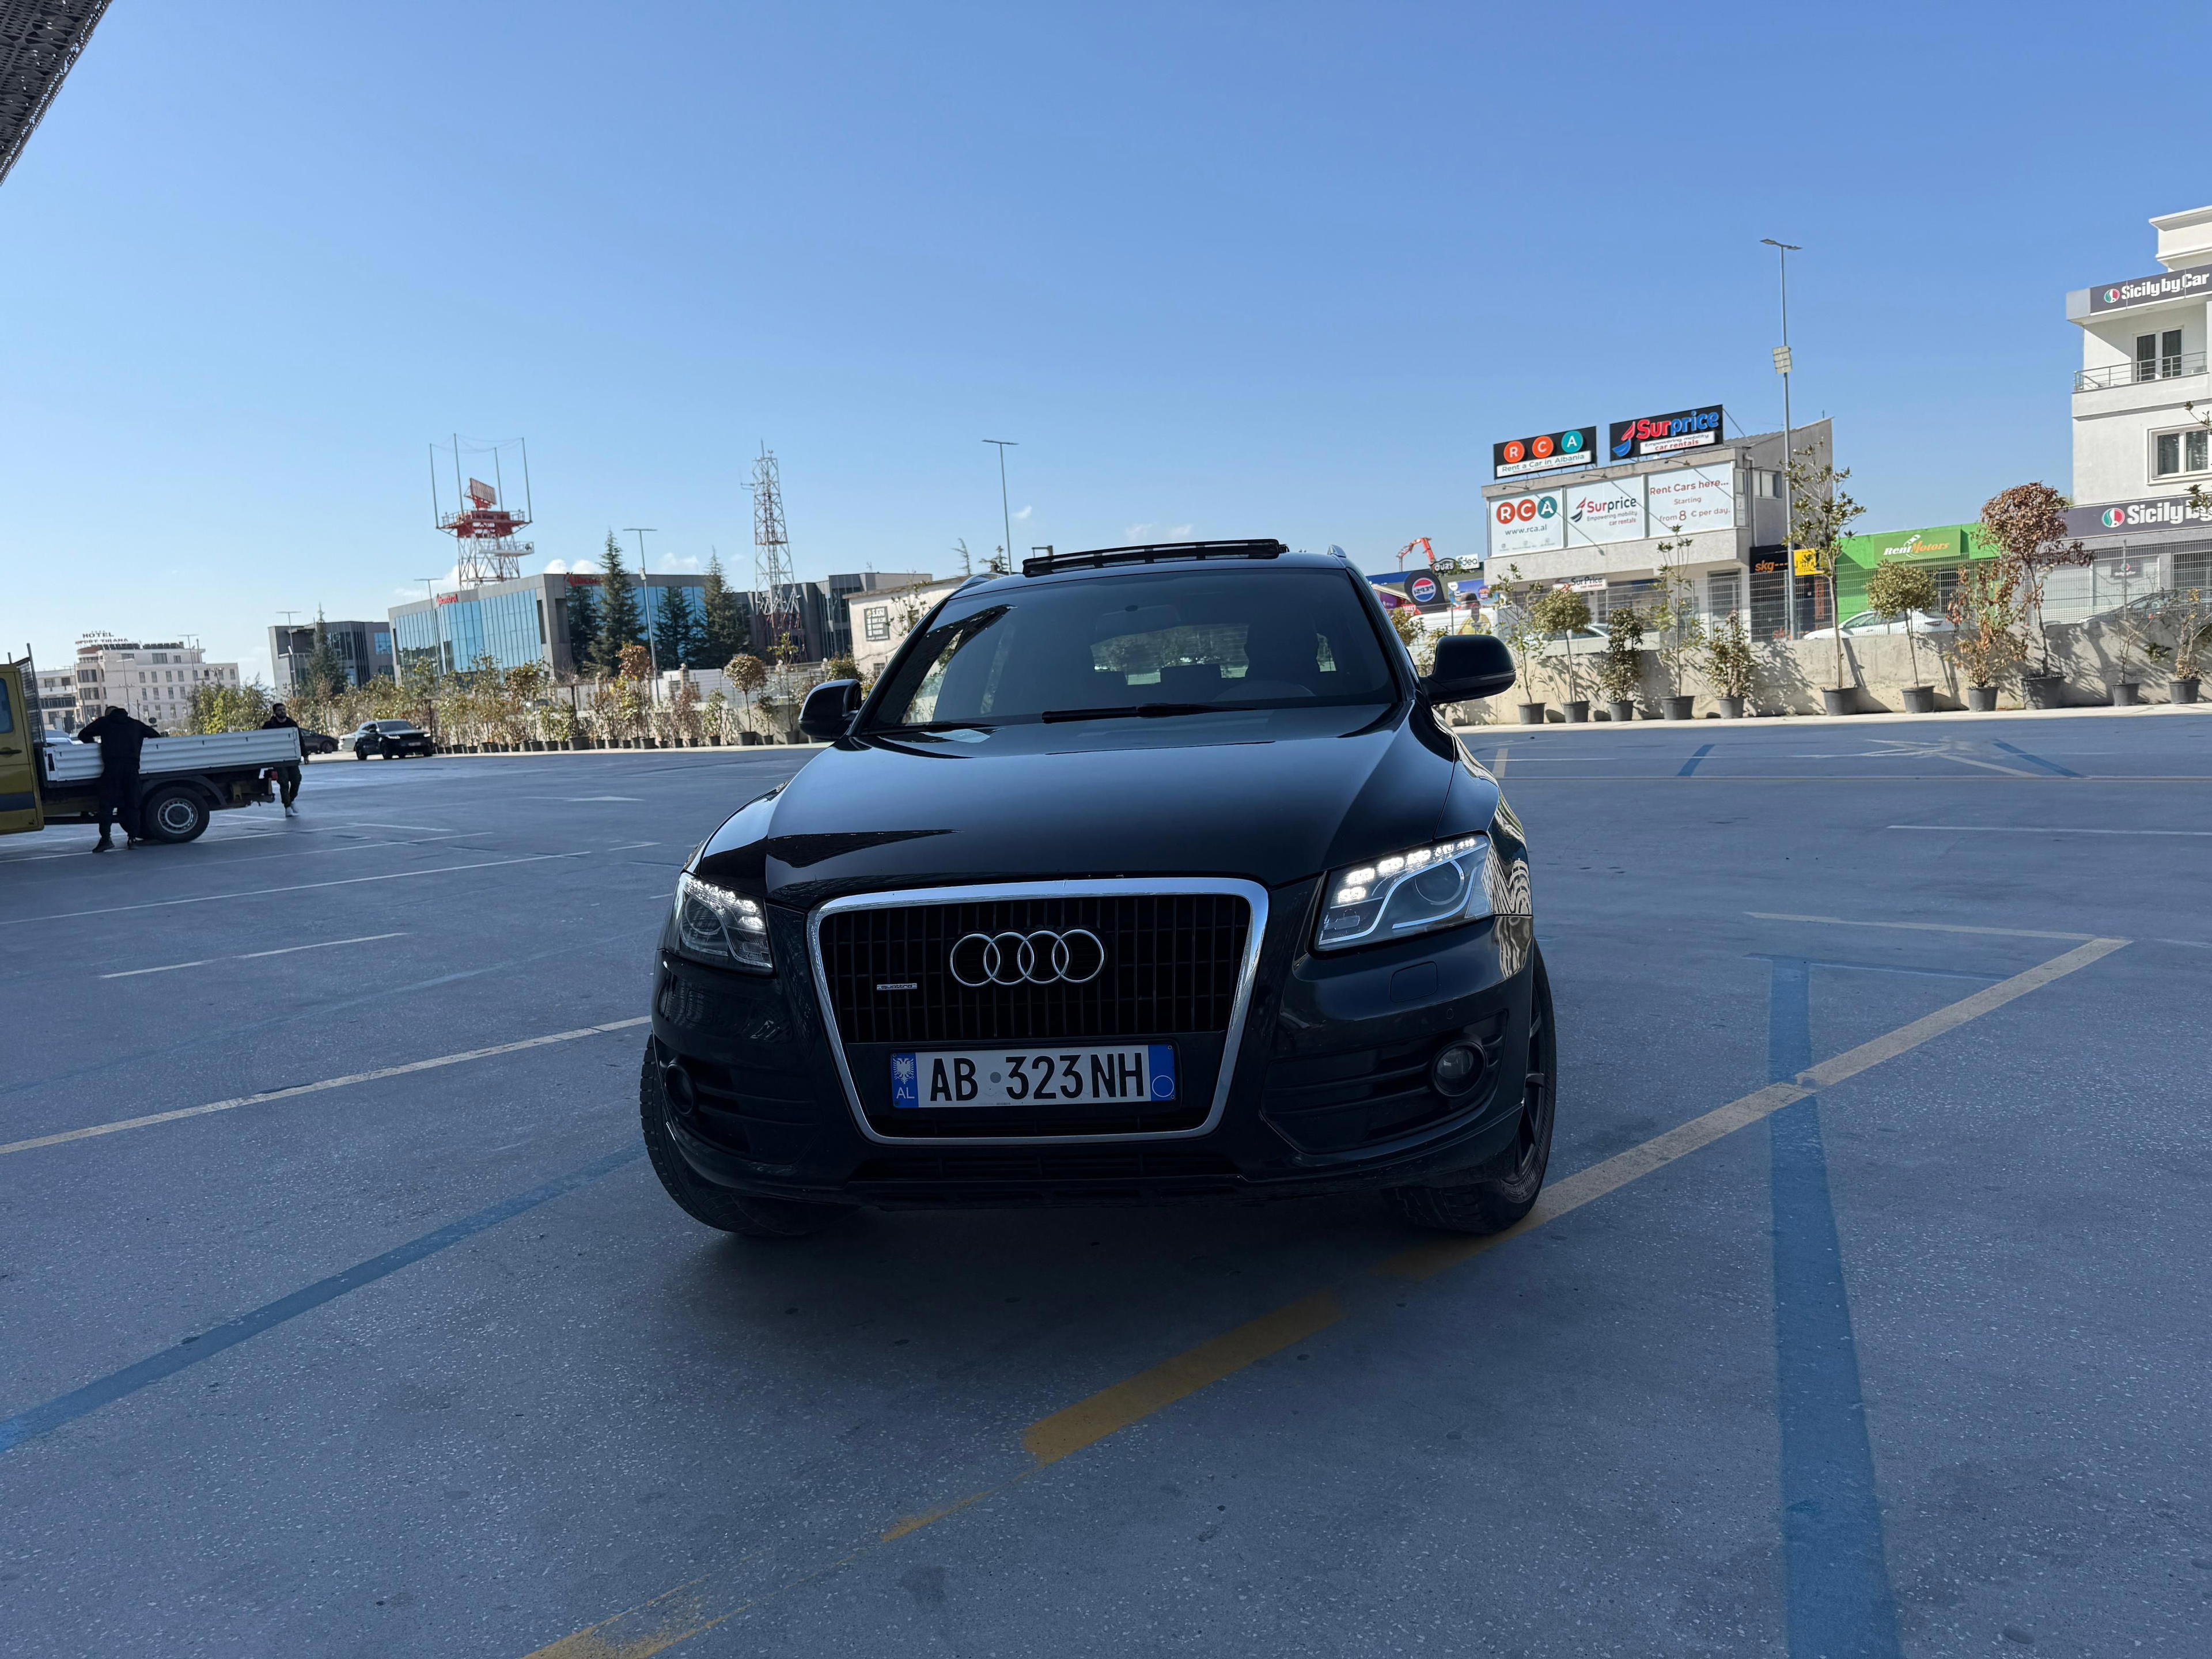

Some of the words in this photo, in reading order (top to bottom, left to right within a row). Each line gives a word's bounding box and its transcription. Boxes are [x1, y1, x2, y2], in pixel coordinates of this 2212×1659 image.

[2121, 281, 2160, 300] Sicily
[2161, 278, 2180, 293] by
[2181, 273, 2210, 288] Car
[1637, 411, 1719, 440] Surprice
[1669, 440, 1699, 449] rentals
[1554, 453, 1584, 464] Albania
[1650, 486, 1671, 495] Rent
[1674, 483, 1696, 492] Cars
[1587, 497, 1637, 513] Surprice
[1674, 497, 1702, 505] Starting
[1501, 500, 1554, 520] RCA
[1679, 510, 1687, 521] 8
[1699, 510, 1712, 518] per
[2127, 502, 2184, 525] Sicily
[1505, 524, 1547, 535] www.rca.al
[930, 1057, 978, 1102] AB
[896, 1086, 915, 1099] AL
